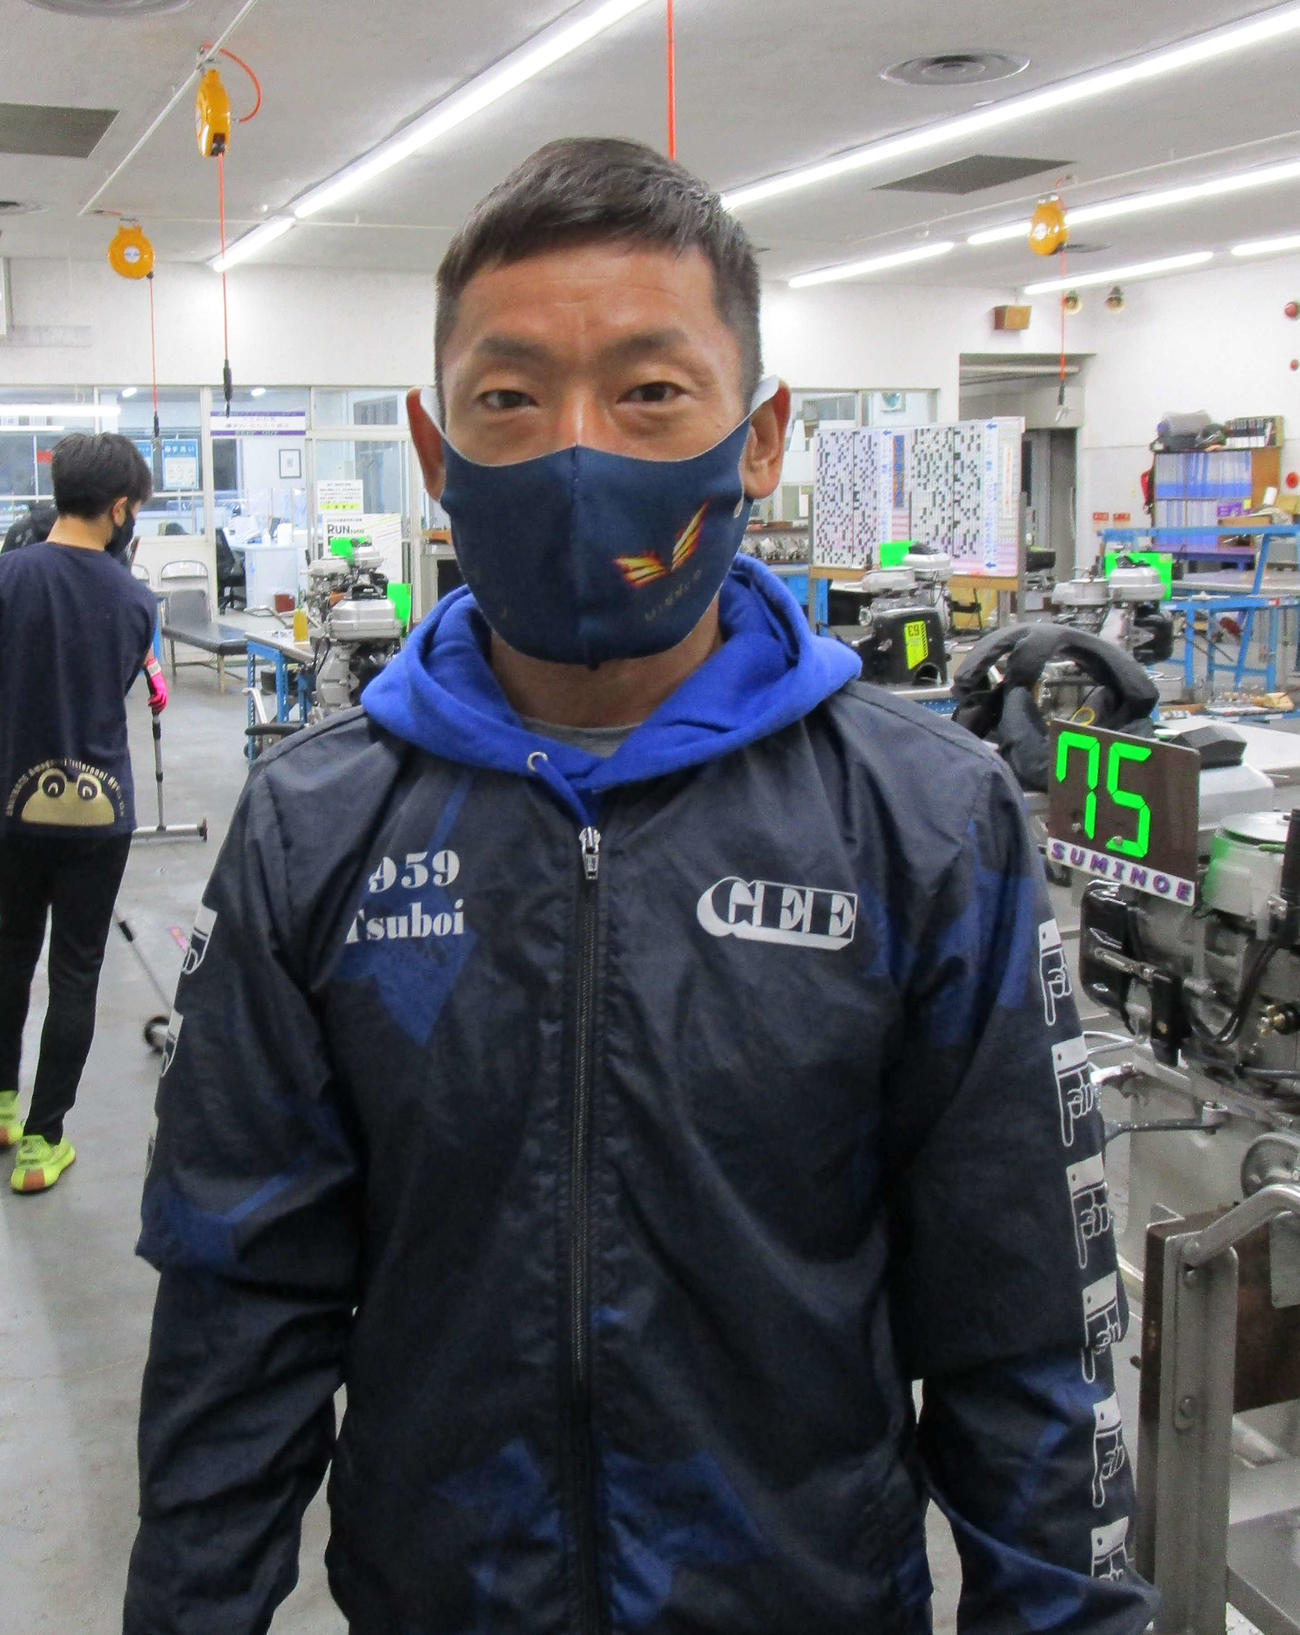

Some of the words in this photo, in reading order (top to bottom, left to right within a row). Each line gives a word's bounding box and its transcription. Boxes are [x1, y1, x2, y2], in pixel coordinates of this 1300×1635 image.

[327, 524, 350, 534] RUN
[1056, 731, 1152, 859] 75
[368, 850, 460, 893] 959
[1051, 842, 1193, 900] SUMINOE
